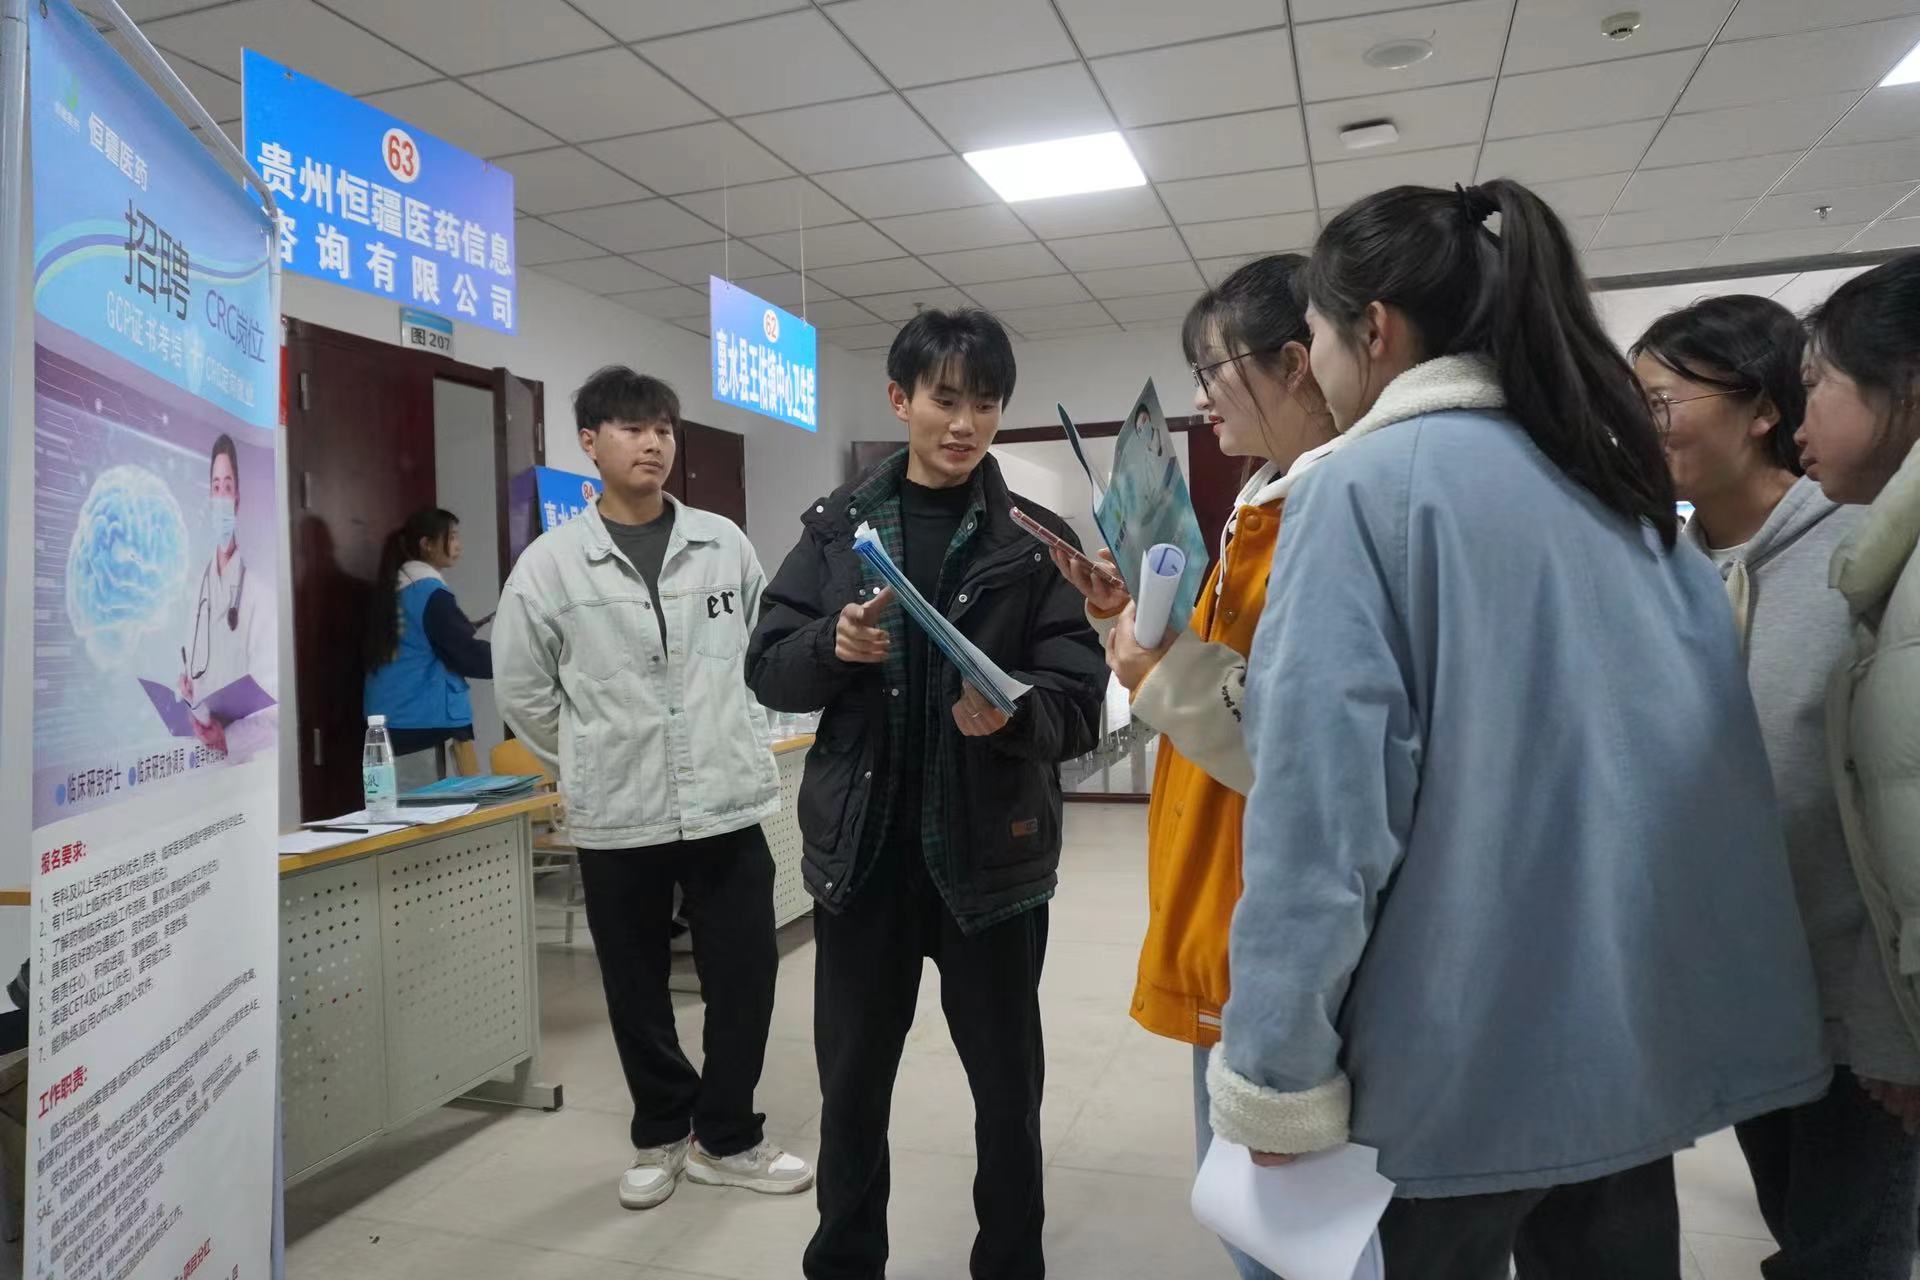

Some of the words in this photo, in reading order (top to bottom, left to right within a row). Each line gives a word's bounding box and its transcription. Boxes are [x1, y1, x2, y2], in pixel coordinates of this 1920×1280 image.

[388, 135, 414, 177] 63
[257, 142, 511, 276] 贵州恒疆医药信息
[124, 200, 190, 320] 招聘
[430, 333, 450, 350] 207
[707, 591, 734, 618] er
[41, 836, 86, 875] 报名要求：
[38, 1060, 87, 1119] 工作职责：
